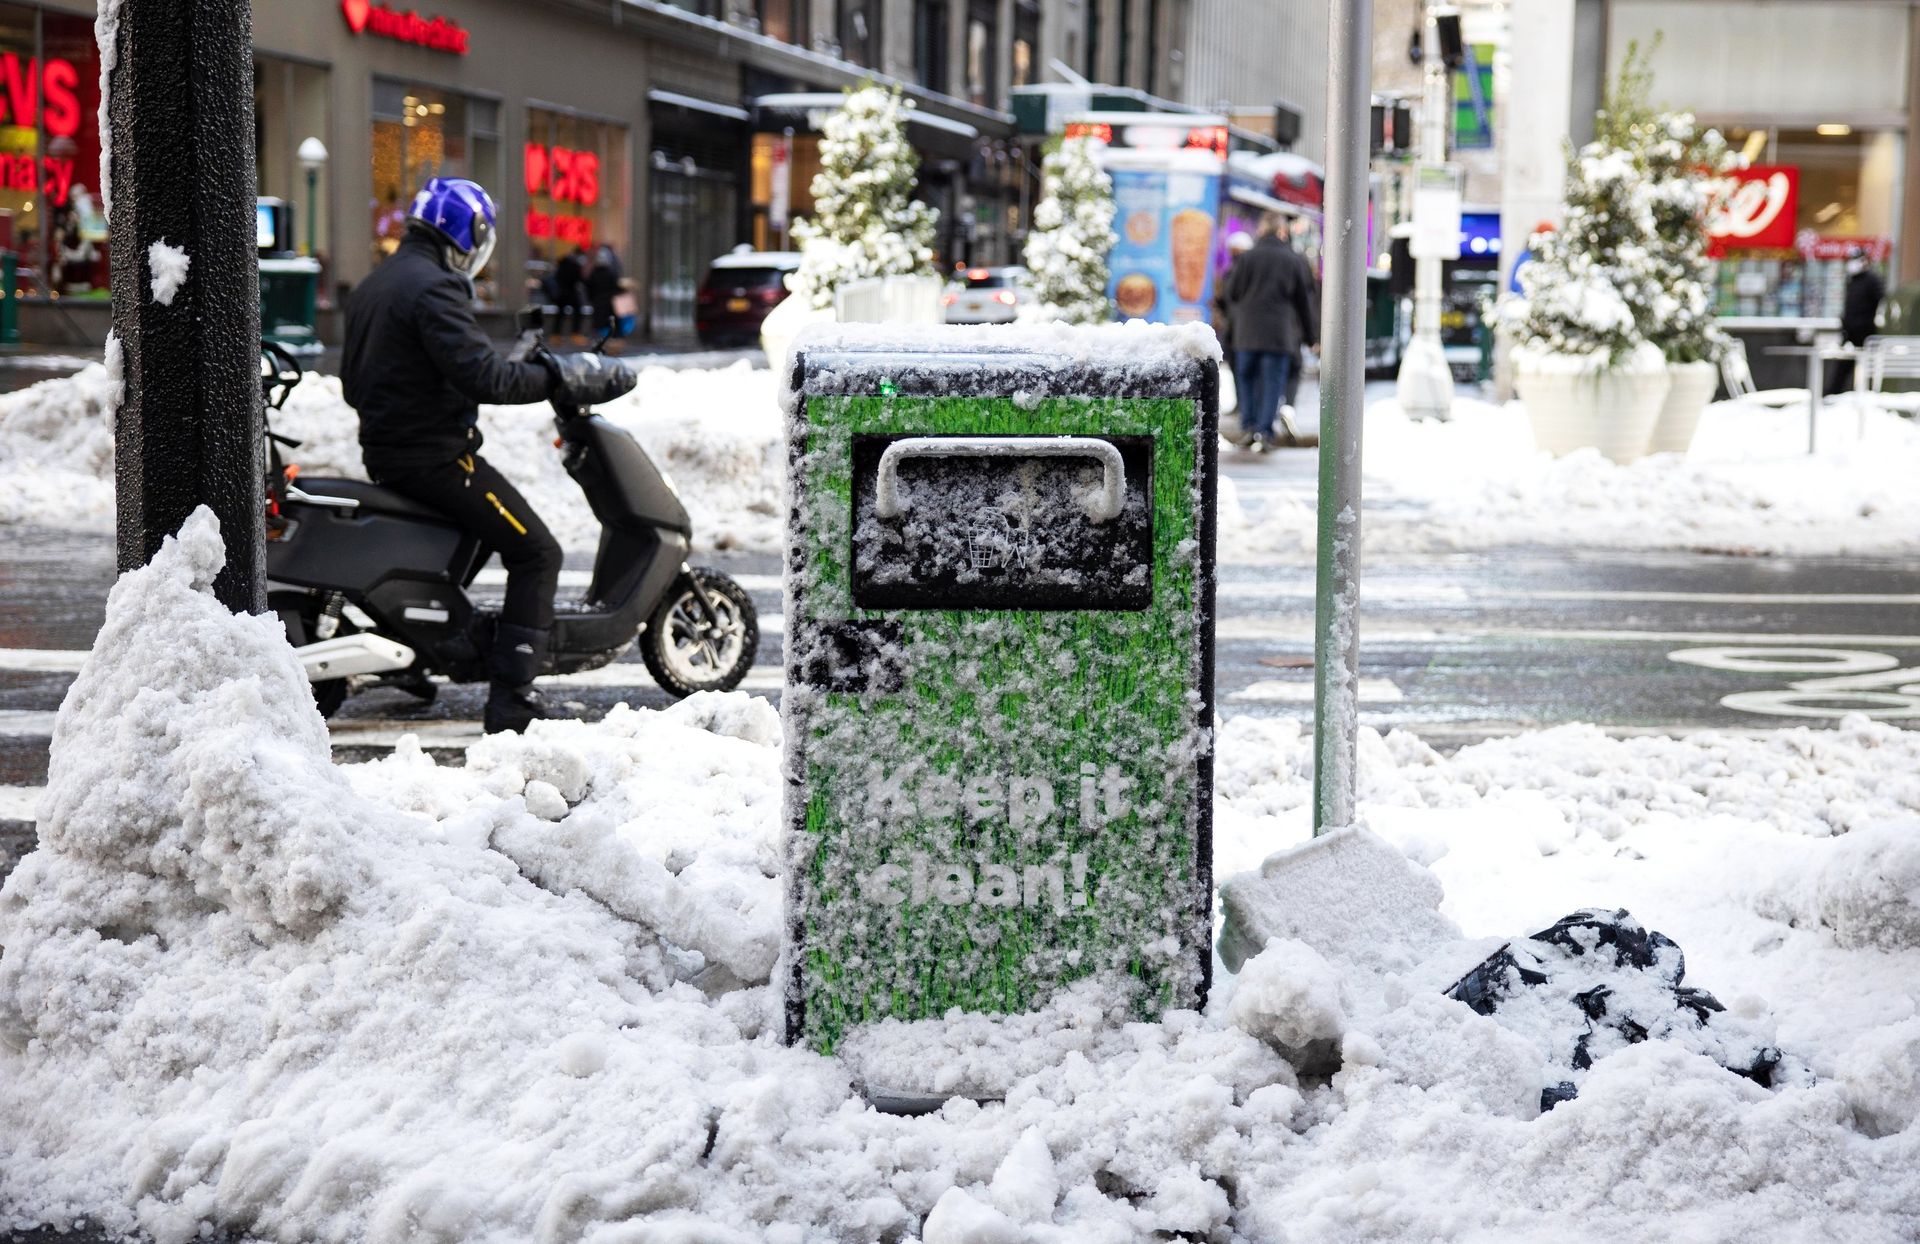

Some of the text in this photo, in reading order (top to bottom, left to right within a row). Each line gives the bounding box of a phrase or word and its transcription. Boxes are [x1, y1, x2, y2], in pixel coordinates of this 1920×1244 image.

[0, 52, 80, 137] VS
[864, 760, 1131, 829] Keep it
[868, 852, 1087, 906] clean!
